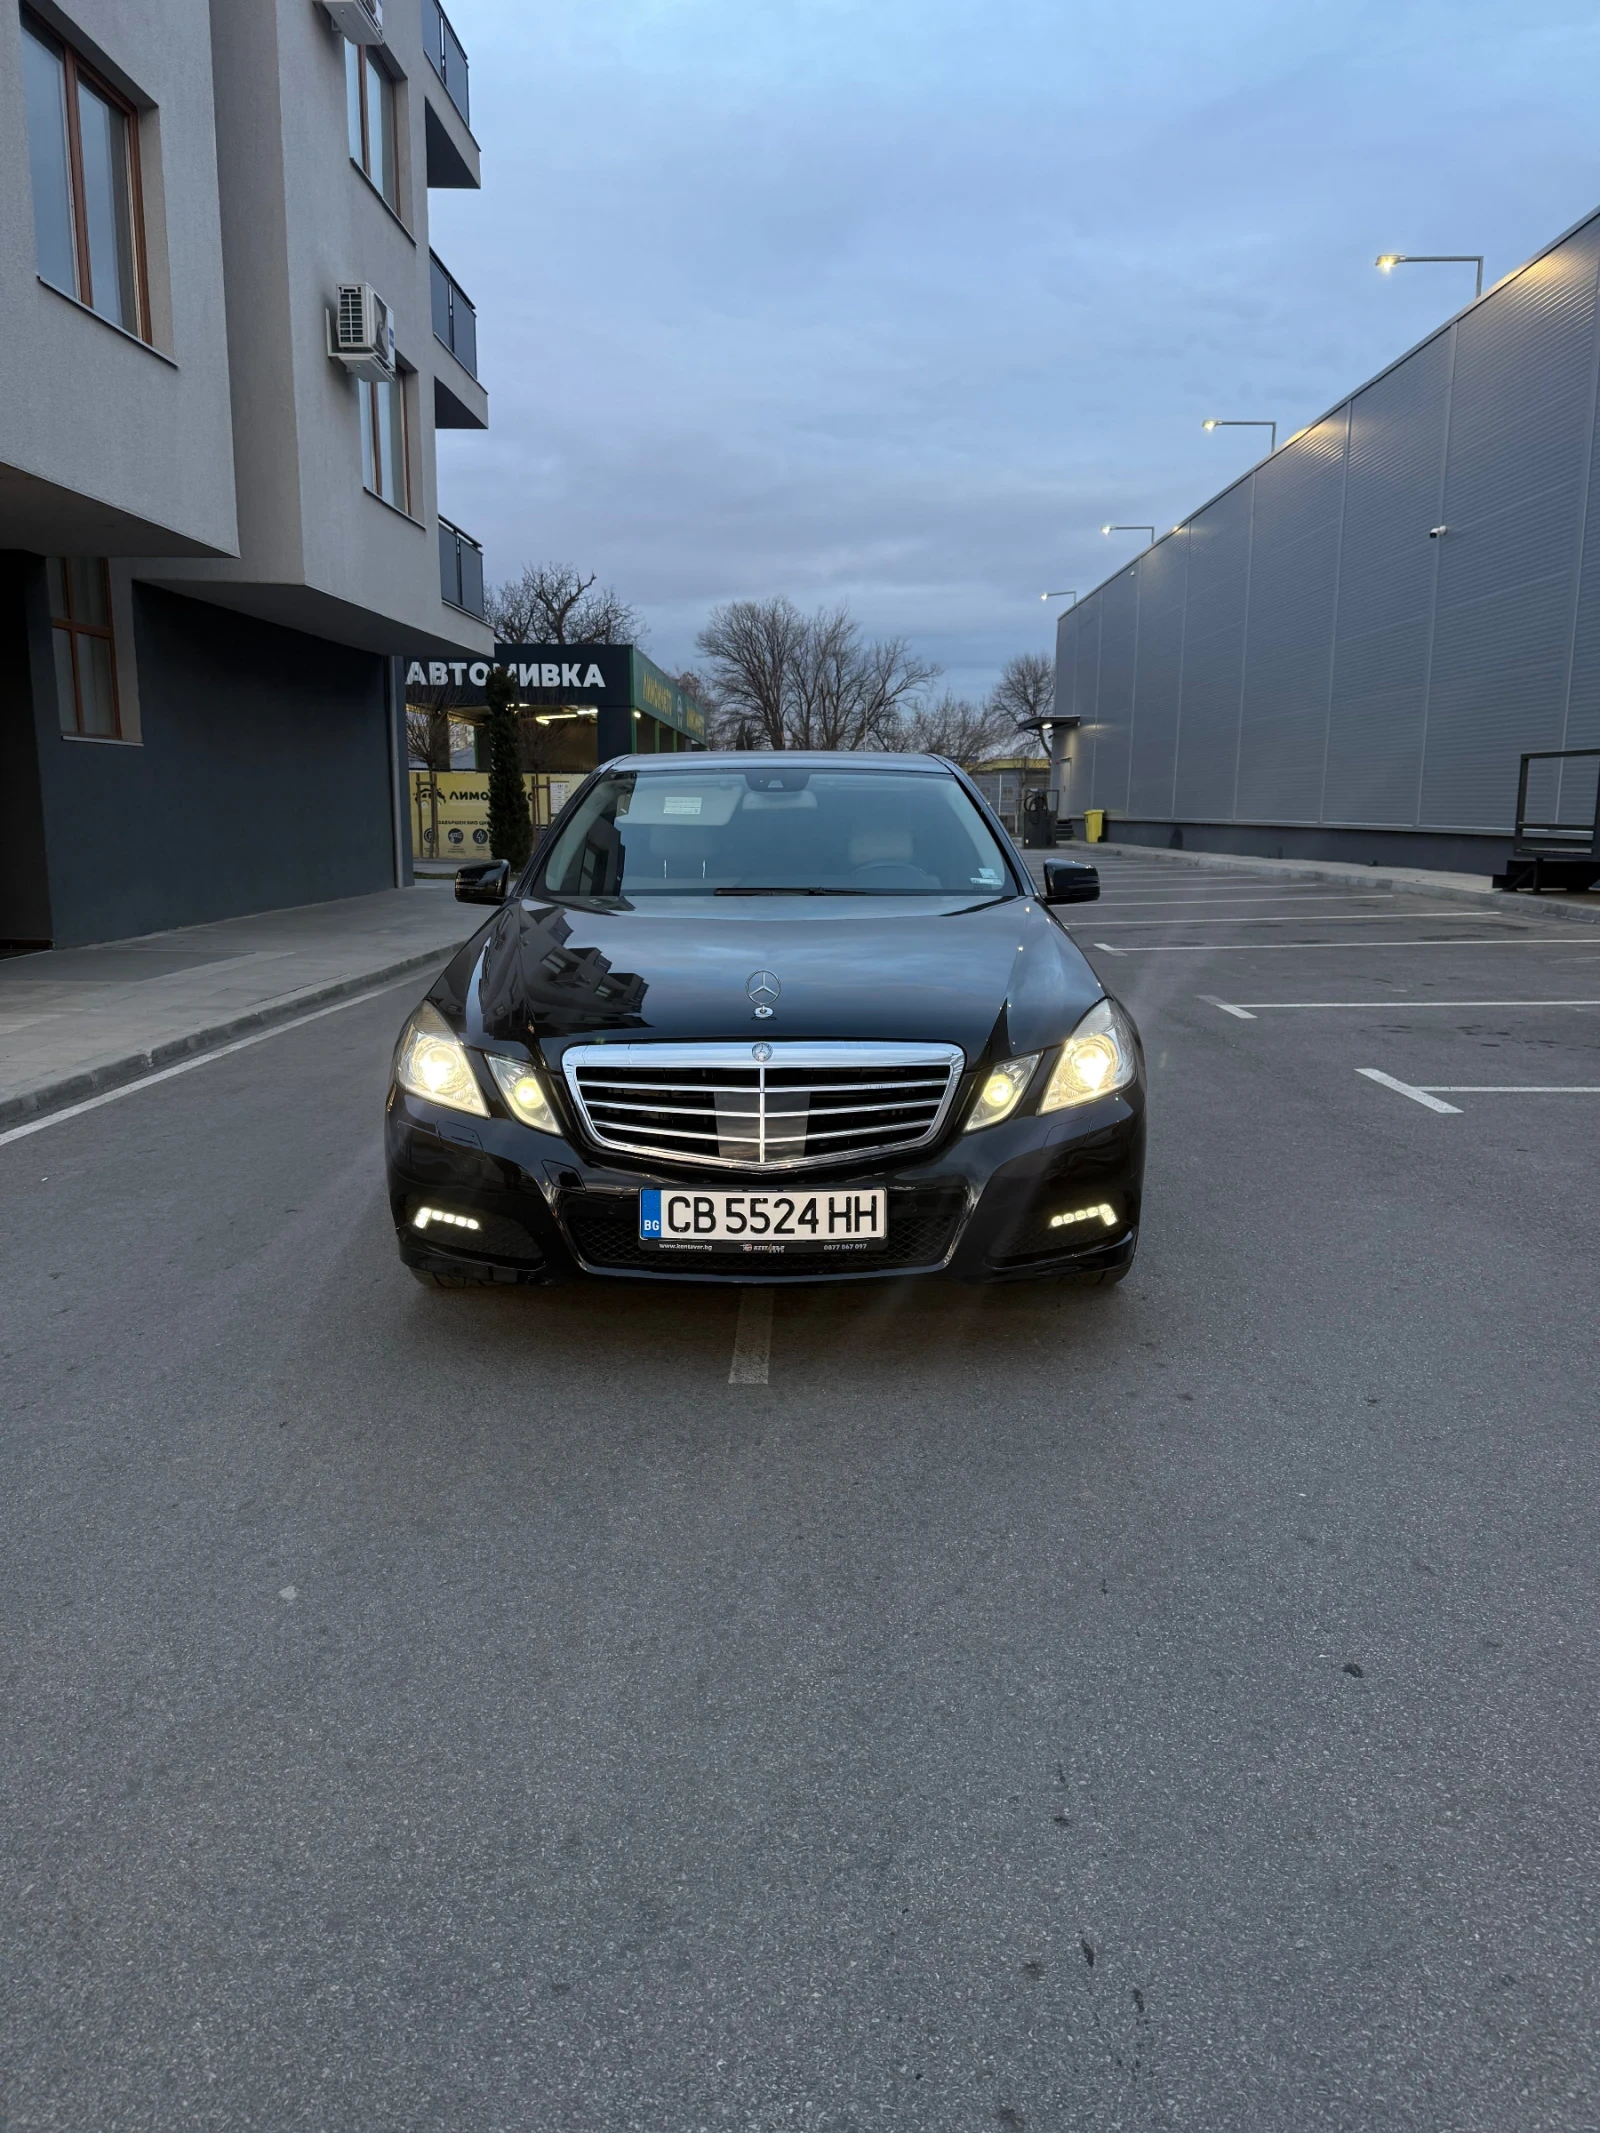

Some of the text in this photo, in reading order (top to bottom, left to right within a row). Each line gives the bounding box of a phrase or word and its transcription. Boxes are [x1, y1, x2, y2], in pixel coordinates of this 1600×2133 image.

[449, 791, 490, 801] ЛИМО
[667, 1195, 877, 1234] CB 5524 HH
[643, 1219, 660, 1231] BG
